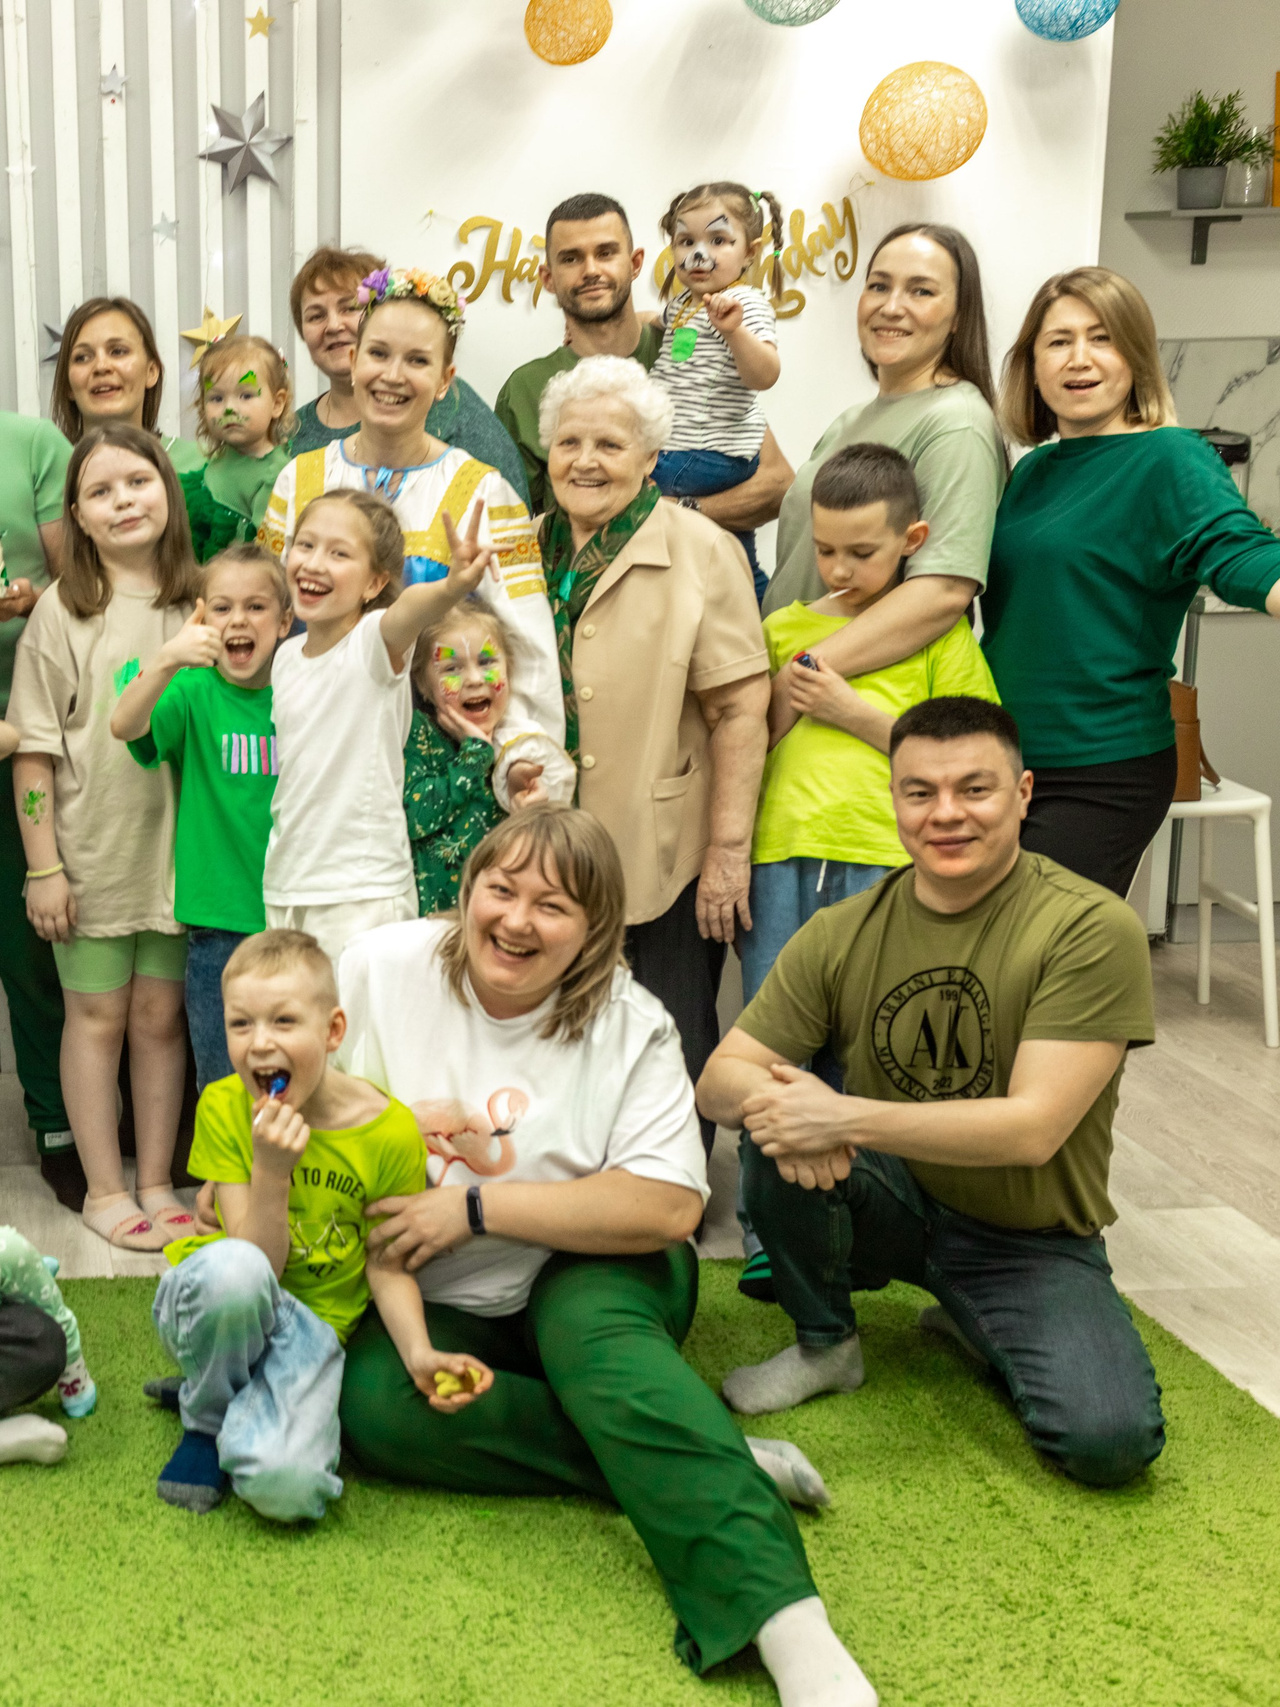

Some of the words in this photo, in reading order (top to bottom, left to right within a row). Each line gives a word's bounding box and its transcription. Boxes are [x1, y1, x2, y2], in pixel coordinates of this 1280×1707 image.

[880, 972, 936, 1025] ARMANI
[877, 1045, 927, 1100] MILANO
[301, 1167, 321, 1187] TO
[325, 1170, 363, 1199] RIDE
